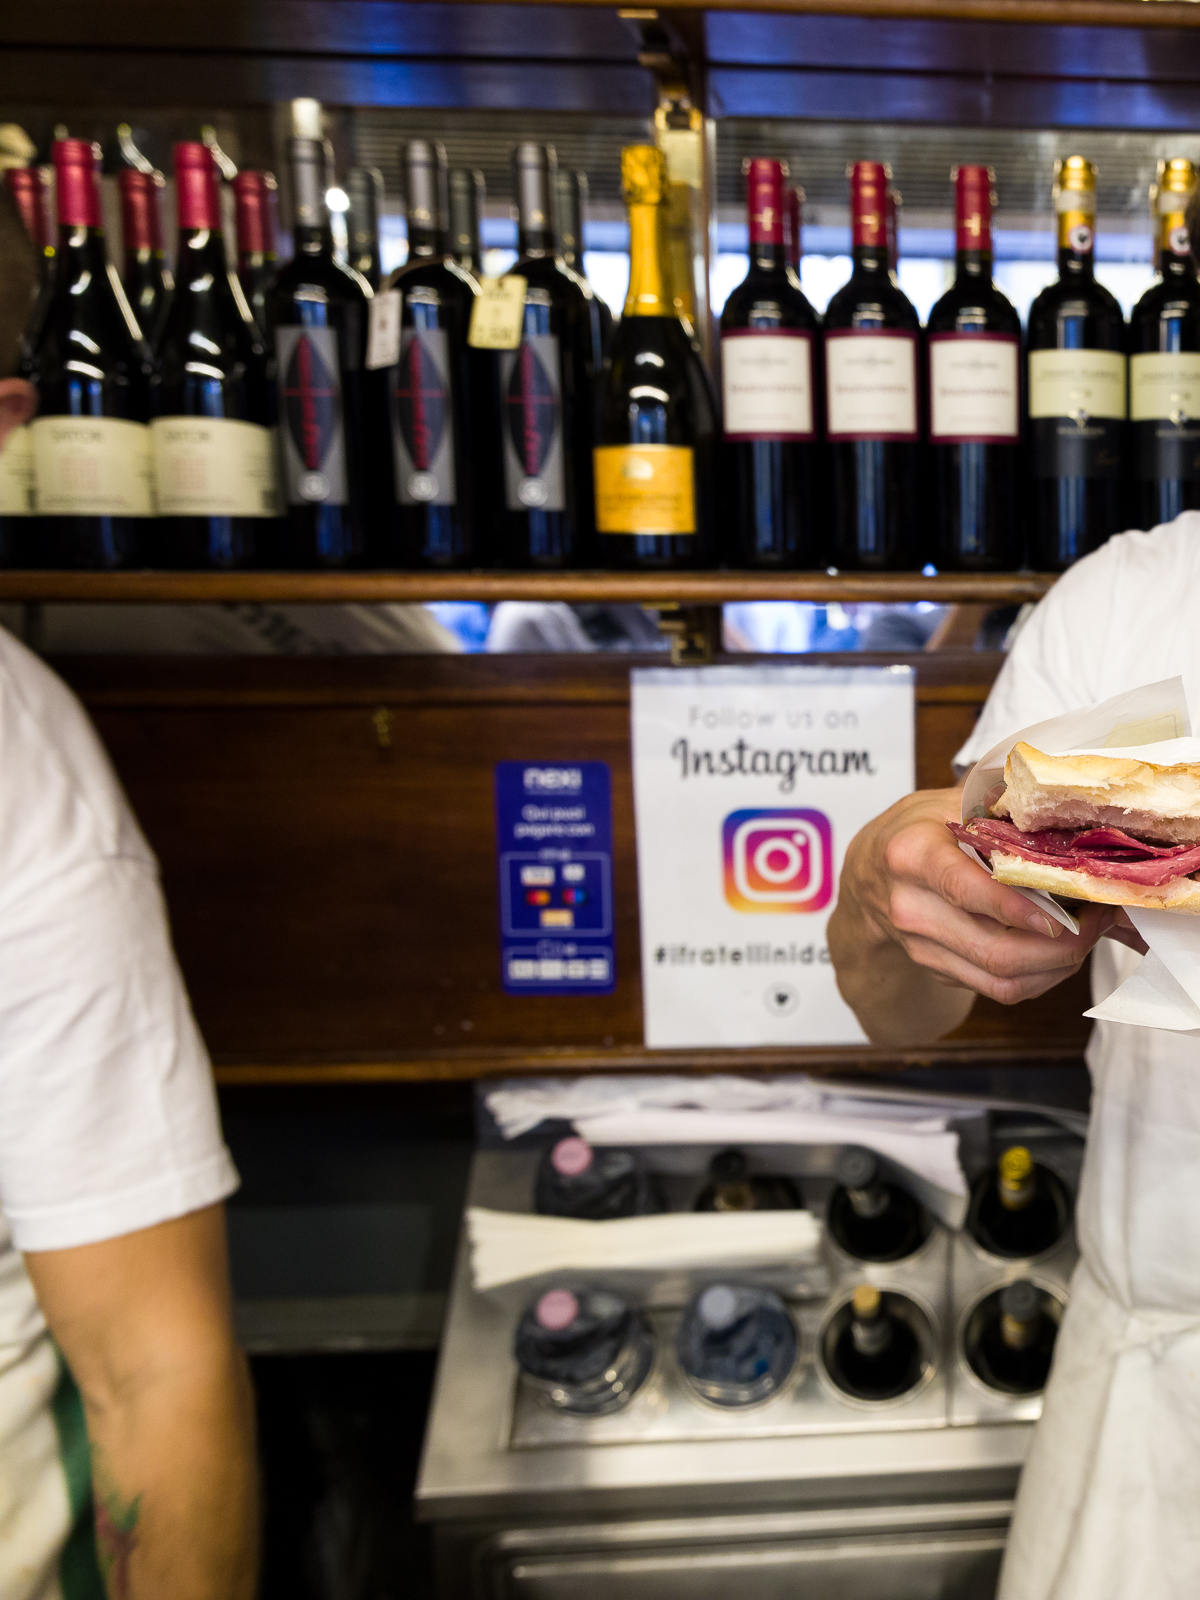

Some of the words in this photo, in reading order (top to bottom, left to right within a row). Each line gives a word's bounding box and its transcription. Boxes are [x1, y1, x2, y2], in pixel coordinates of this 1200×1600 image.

[689, 705, 774, 729] Follow
[786, 709, 814, 729] us
[824, 709, 859, 729] on
[671, 737, 876, 794] Instagram
